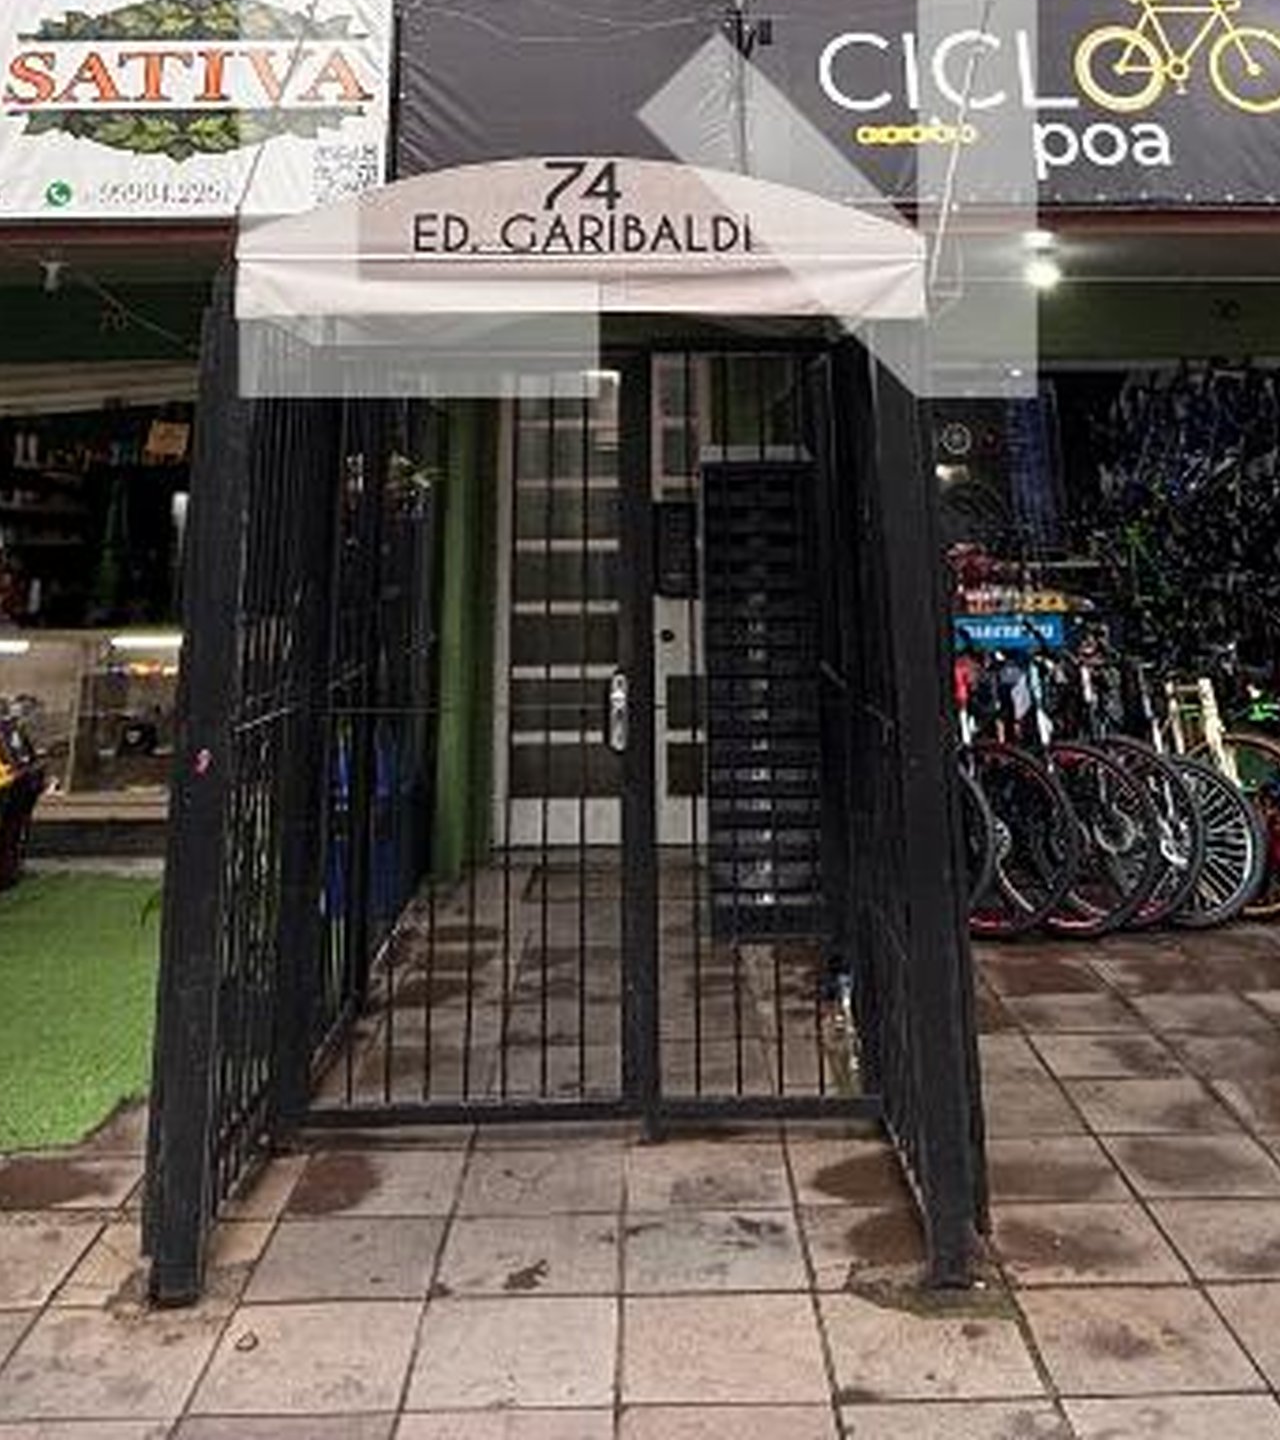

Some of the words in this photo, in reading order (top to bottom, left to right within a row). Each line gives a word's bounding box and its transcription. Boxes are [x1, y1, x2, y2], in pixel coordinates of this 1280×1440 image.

[2, 49, 376, 106] SATIVA
[1032, 120, 1173, 179] poa
[541, 161, 623, 210] 74
[413, 213, 478, 253] ED.
[499, 212, 753, 254] GARIBALDI
